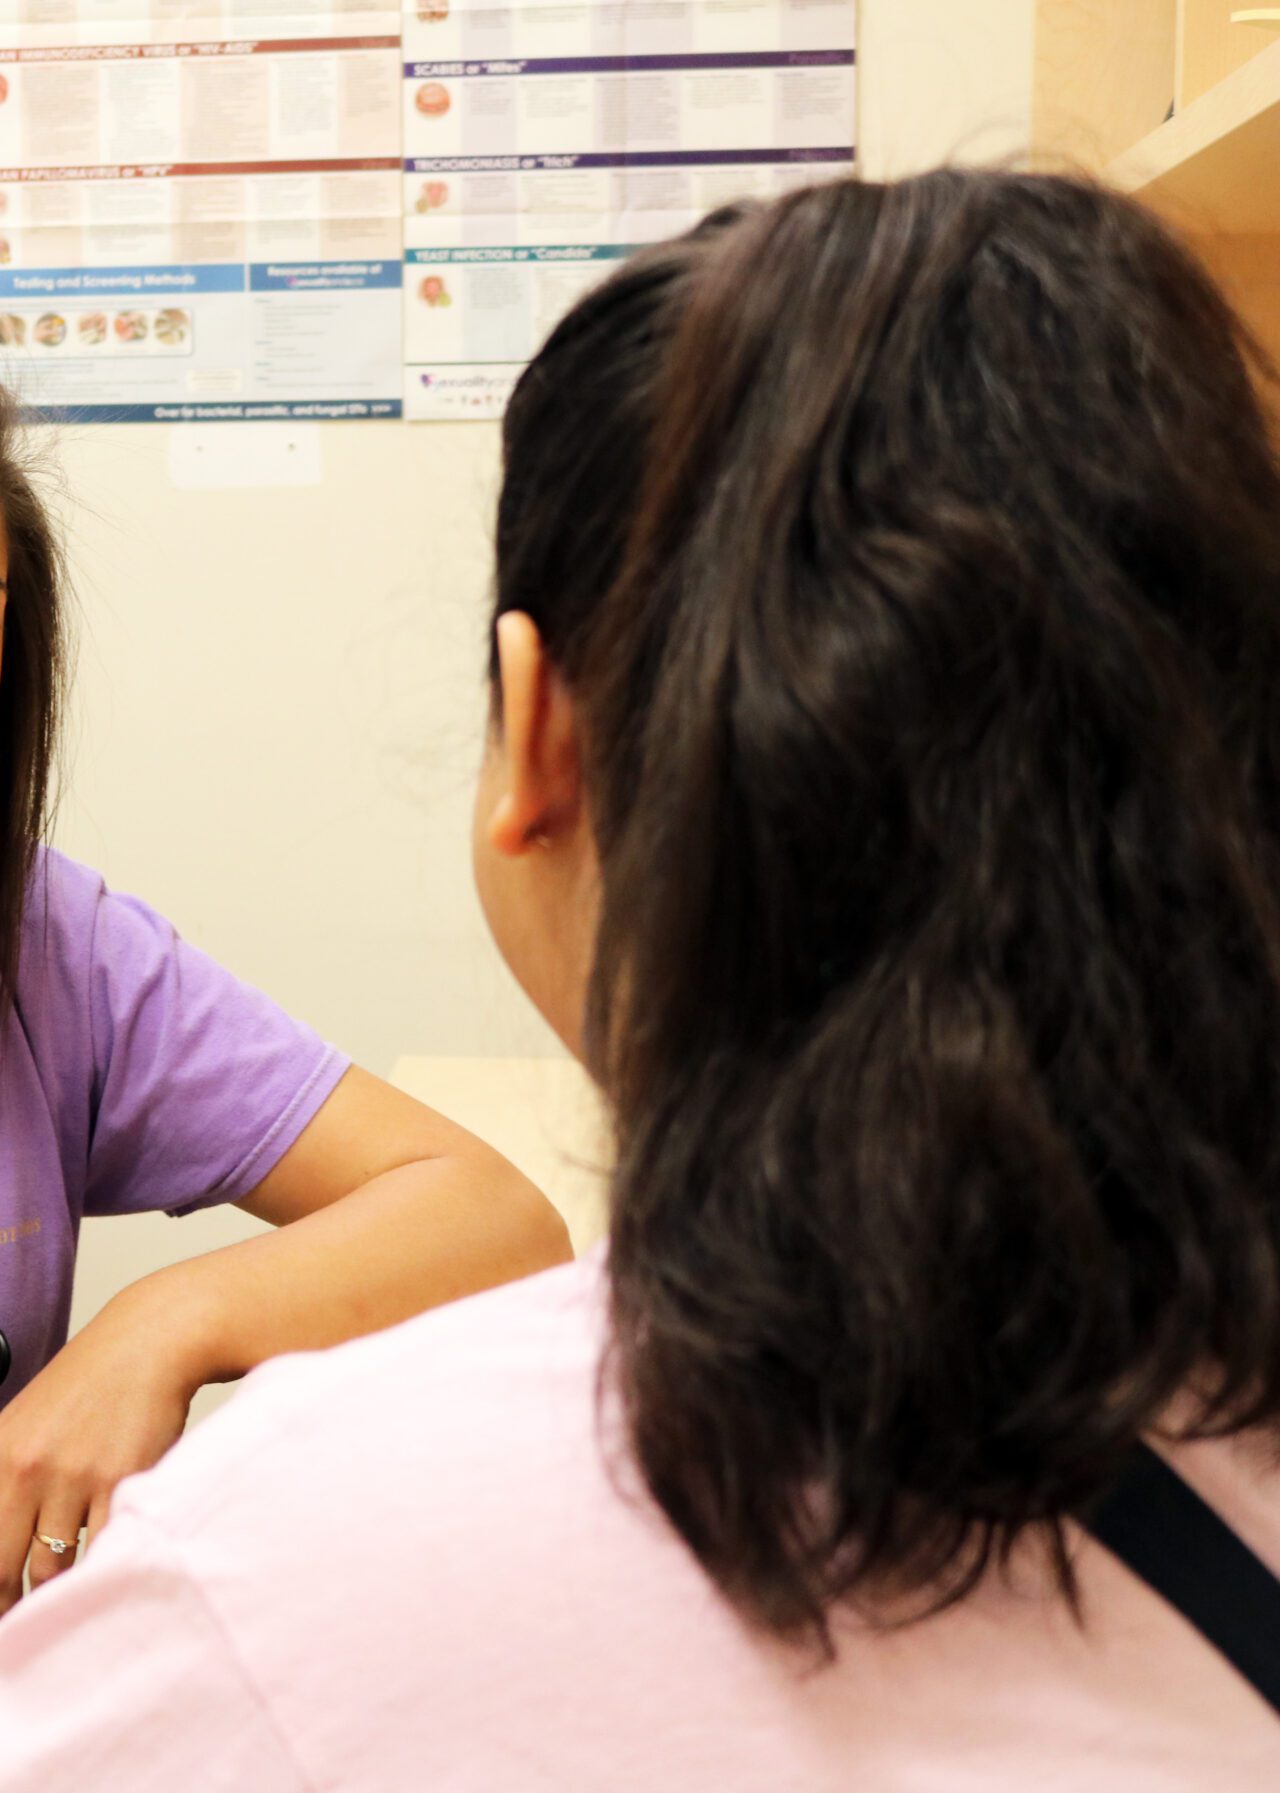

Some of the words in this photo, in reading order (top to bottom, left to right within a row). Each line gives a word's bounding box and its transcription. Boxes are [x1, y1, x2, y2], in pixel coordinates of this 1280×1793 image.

[413, 64, 464, 77] SCABIES
[13, 277, 54, 291] Testing
[56, 276, 80, 288] and
[83, 274, 141, 288] Screening
[144, 273, 196, 286] Methods
